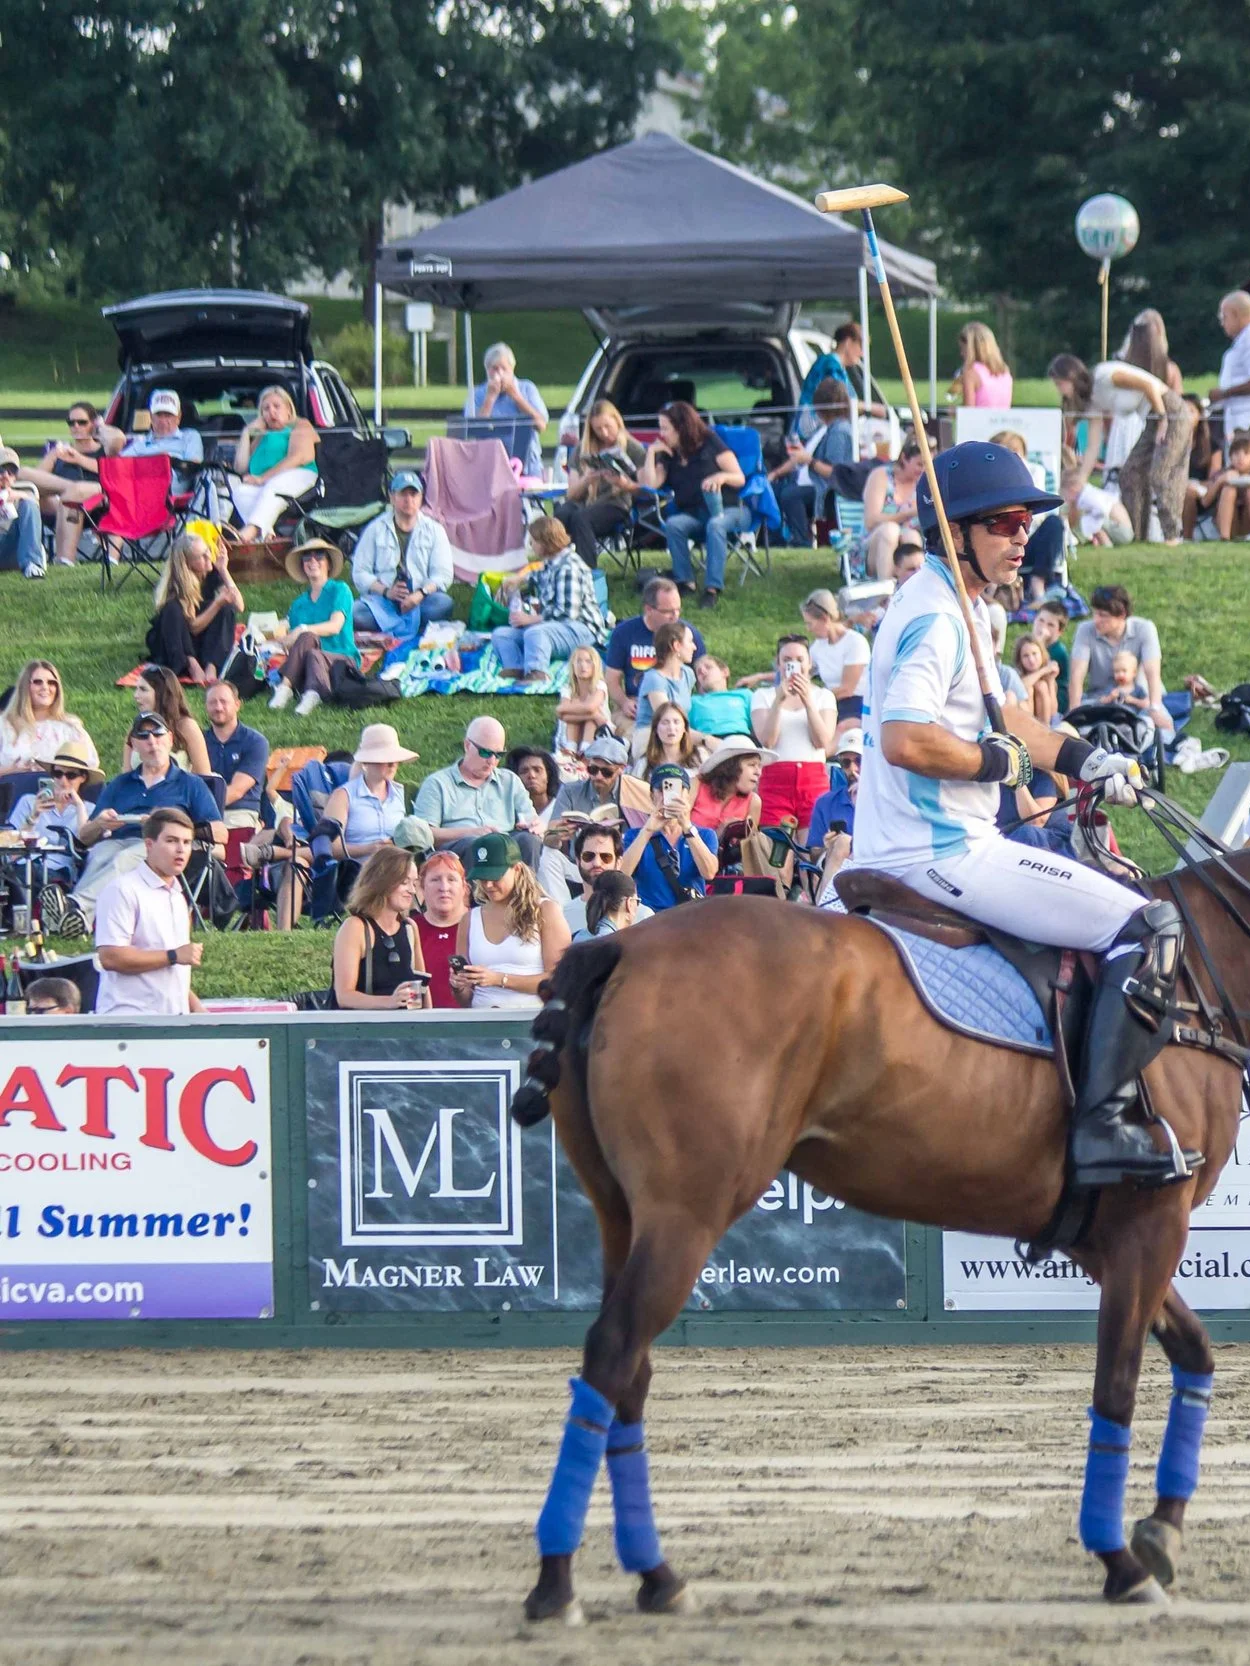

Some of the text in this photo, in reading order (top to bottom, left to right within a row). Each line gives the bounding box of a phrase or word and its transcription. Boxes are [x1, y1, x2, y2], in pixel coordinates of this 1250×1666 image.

[1019, 858, 1073, 881] PRISA
[0, 1064, 258, 1167] ATIC
[0, 1152, 132, 1171] COOLING
[363, 1108, 497, 1199] ML
[38, 1203, 252, 1238] Summer!
[322, 1257, 545, 1288] MAGNER LAW
[695, 1260, 840, 1284] erlaw.com
[0, 1277, 144, 1303] icva.com
